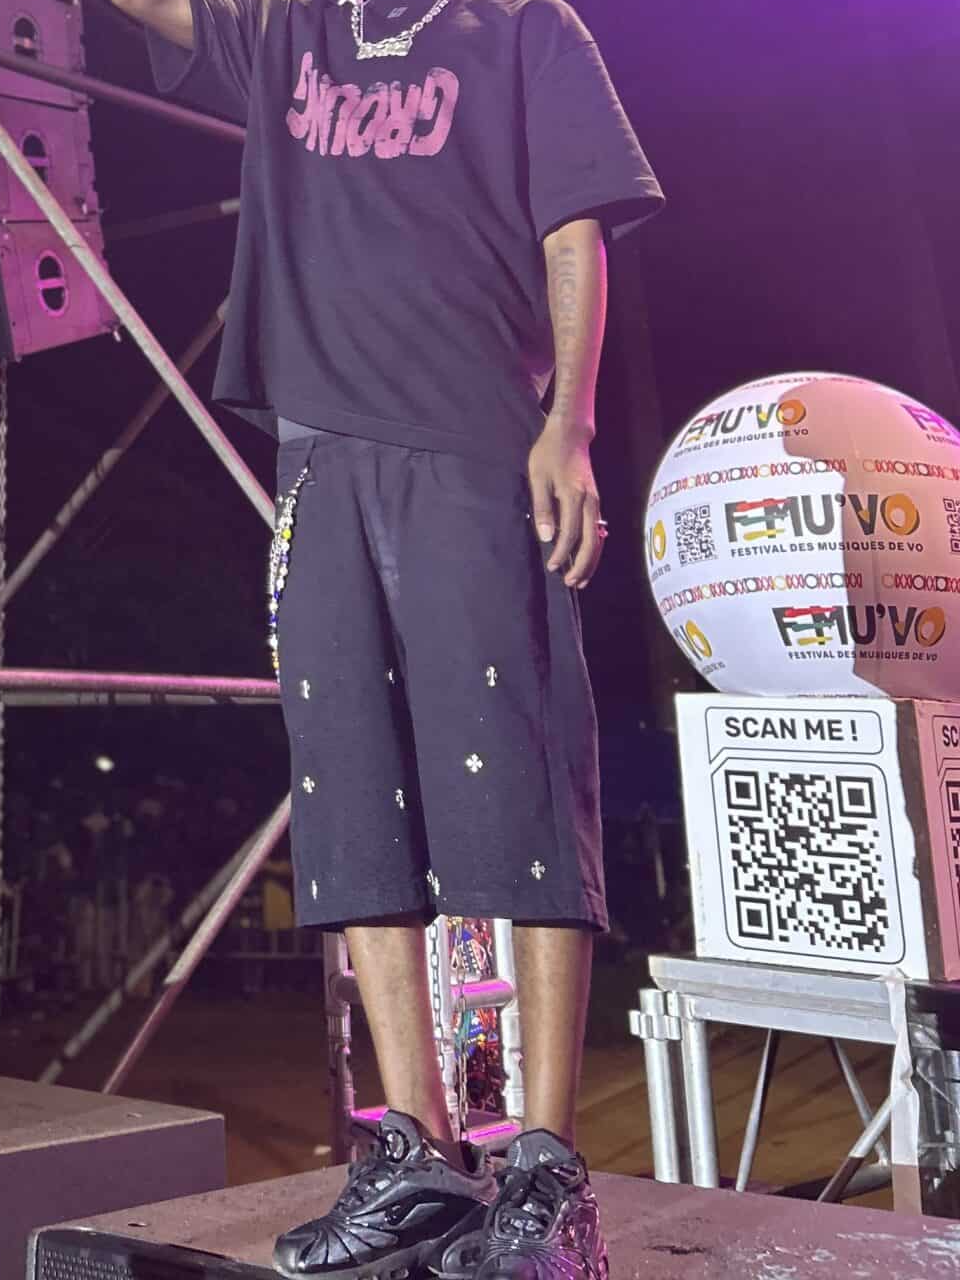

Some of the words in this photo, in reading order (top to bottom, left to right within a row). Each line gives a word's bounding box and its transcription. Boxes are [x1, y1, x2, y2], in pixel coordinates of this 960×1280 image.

[731, 544, 787, 557] FESTIVAL
[791, 542, 814, 552] DES
[818, 540, 885, 552] MUSIQUES
[888, 541, 904, 551] DE
[908, 543, 924, 552] VO
[789, 650, 835, 660] FESTIVAL
[837, 650, 856, 659] DES
[859, 651, 910, 660] MUSIQUES
[912, 652, 925, 660] DE
[926, 653, 938, 661] VO
[724, 716, 797, 739] SCAN
[805, 719, 844, 741] ME
[851, 719, 858, 741] !
